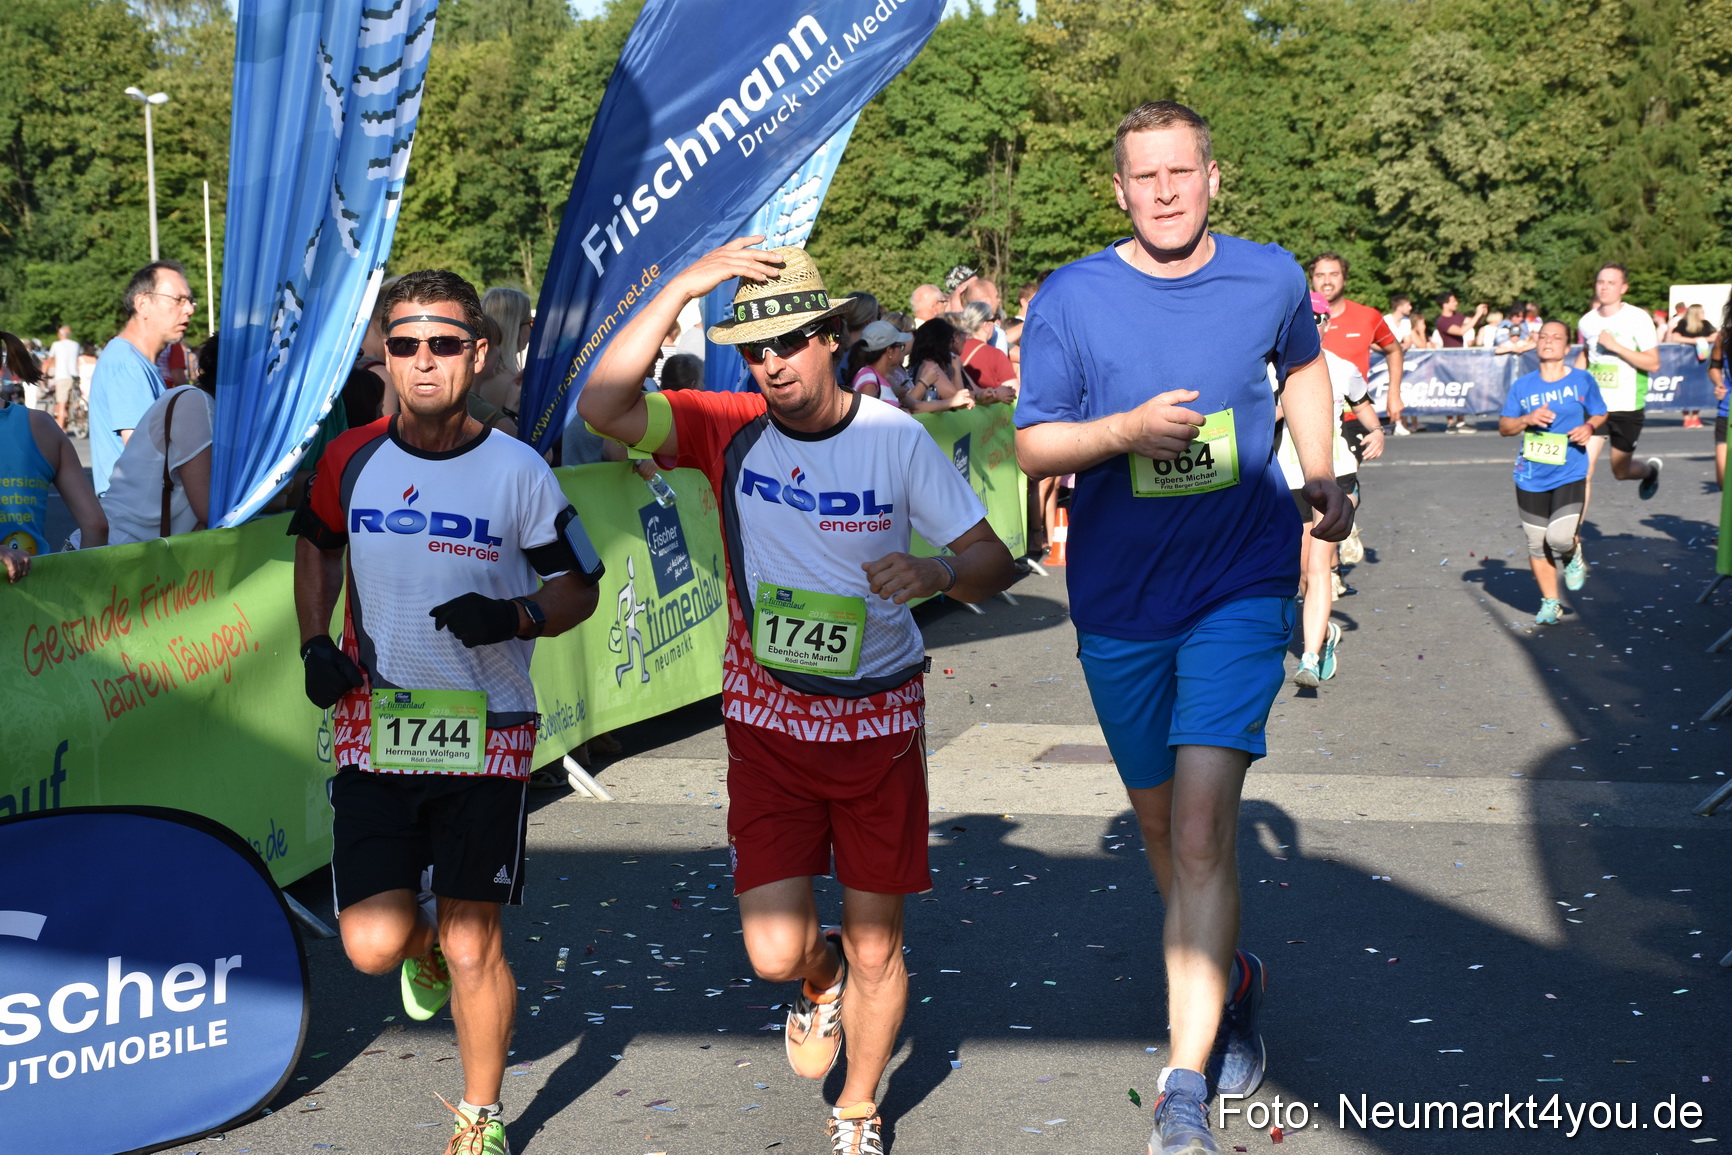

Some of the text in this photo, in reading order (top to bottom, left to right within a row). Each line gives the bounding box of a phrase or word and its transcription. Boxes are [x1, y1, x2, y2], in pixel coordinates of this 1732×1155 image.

[737, 93, 802, 157] Druck
[801, 46, 844, 97] und
[581, 14, 828, 278] Frischmann
[1375, 377, 1475, 397] Fscher
[1152, 443, 1215, 476] 664
[1529, 442, 1560, 456] 1732
[1154, 470, 1218, 485] Egbers Michael
[1174, 482, 1193, 490] Berger
[1194, 479, 1212, 487] GmbH
[652, 525, 678, 549] Fischer
[646, 553, 723, 650] firmenlauf
[23, 569, 216, 677] Gesunde Firmen
[766, 614, 848, 654] 1745
[91, 602, 260, 722] laufen länger!
[655, 633, 694, 673] neumarkt
[768, 645, 838, 663] Ebenhöch Martin
[800, 659, 818, 667] GmbH
[387, 701, 426, 710] firmenlauf
[726, 699, 918, 743] AVIA AVIA AVIA
[386, 717, 471, 749] 1744
[385, 747, 470, 760] Herrmann Wolfgang
